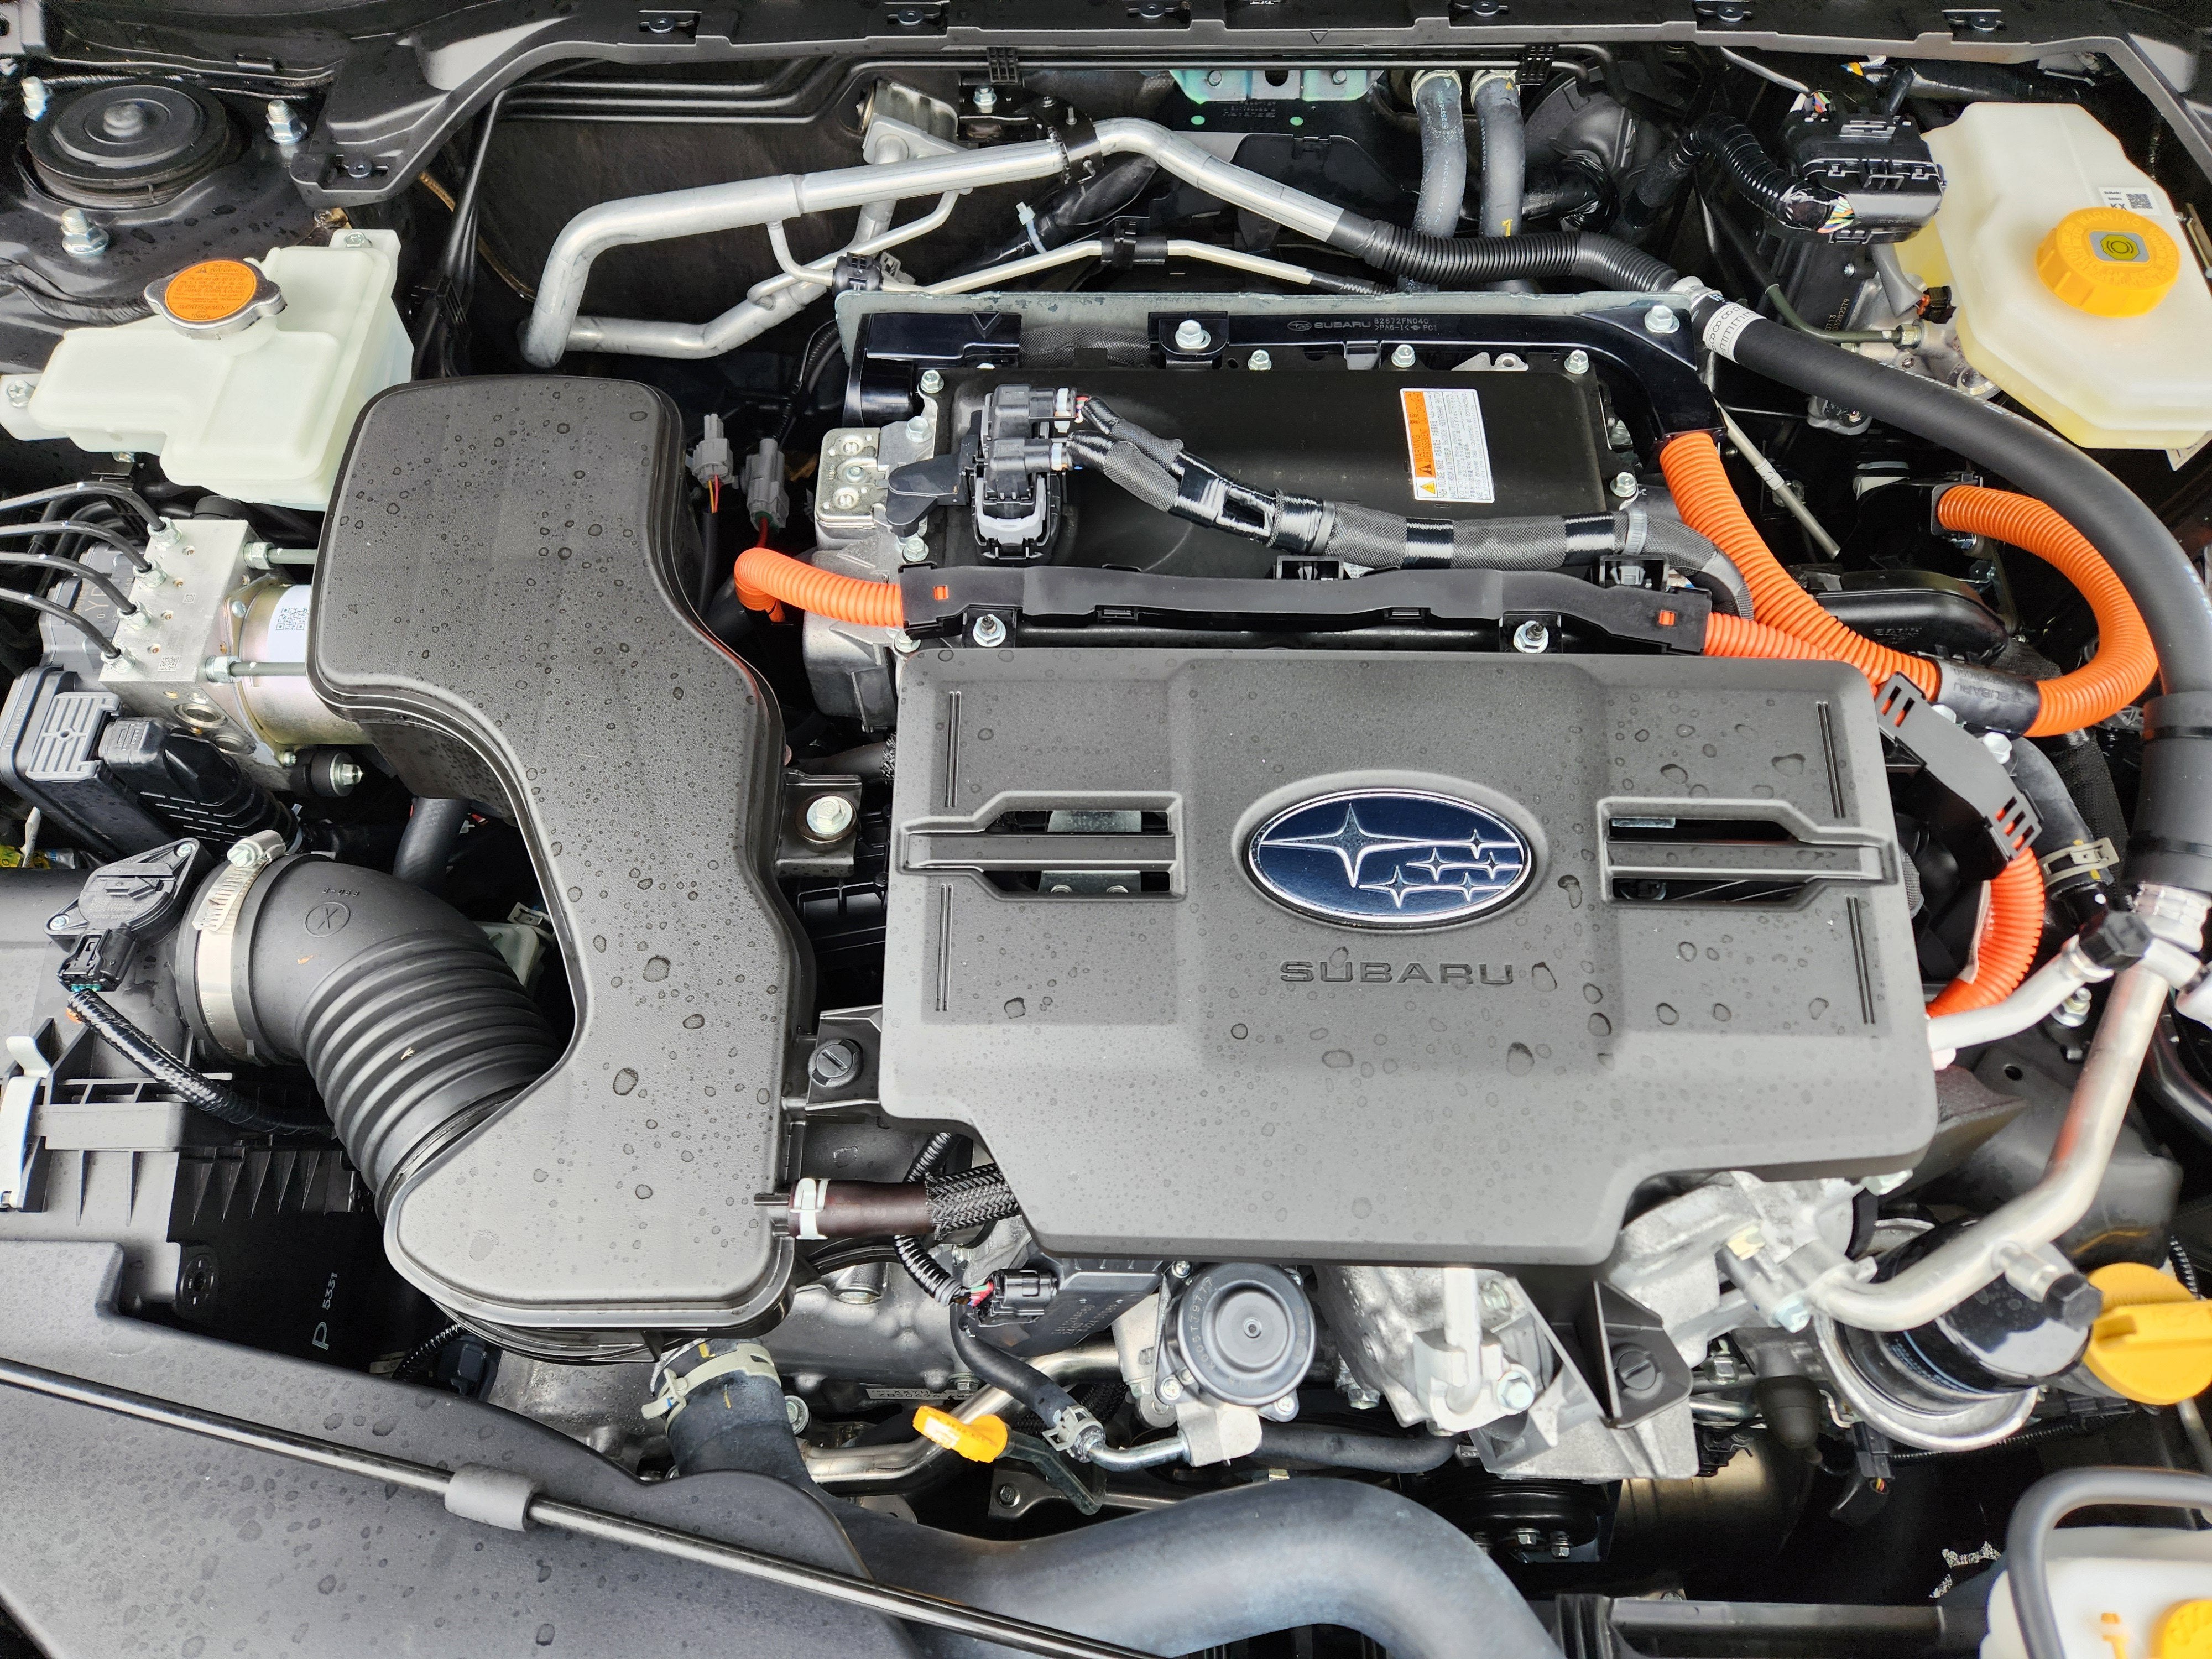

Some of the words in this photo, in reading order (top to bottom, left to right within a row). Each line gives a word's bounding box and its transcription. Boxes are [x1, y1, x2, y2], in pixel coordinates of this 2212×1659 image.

[2076, 210, 2142, 227] WARNING
[1411, 435, 1423, 462] WARNING
[1419, 427, 1432, 462] AVERTISSEMENT
[1435, 460, 1444, 470] INSIDE
[1280, 961, 1514, 984] SUBARU
[312, 1321, 330, 1351] P
[321, 1272, 338, 1311] 5331
